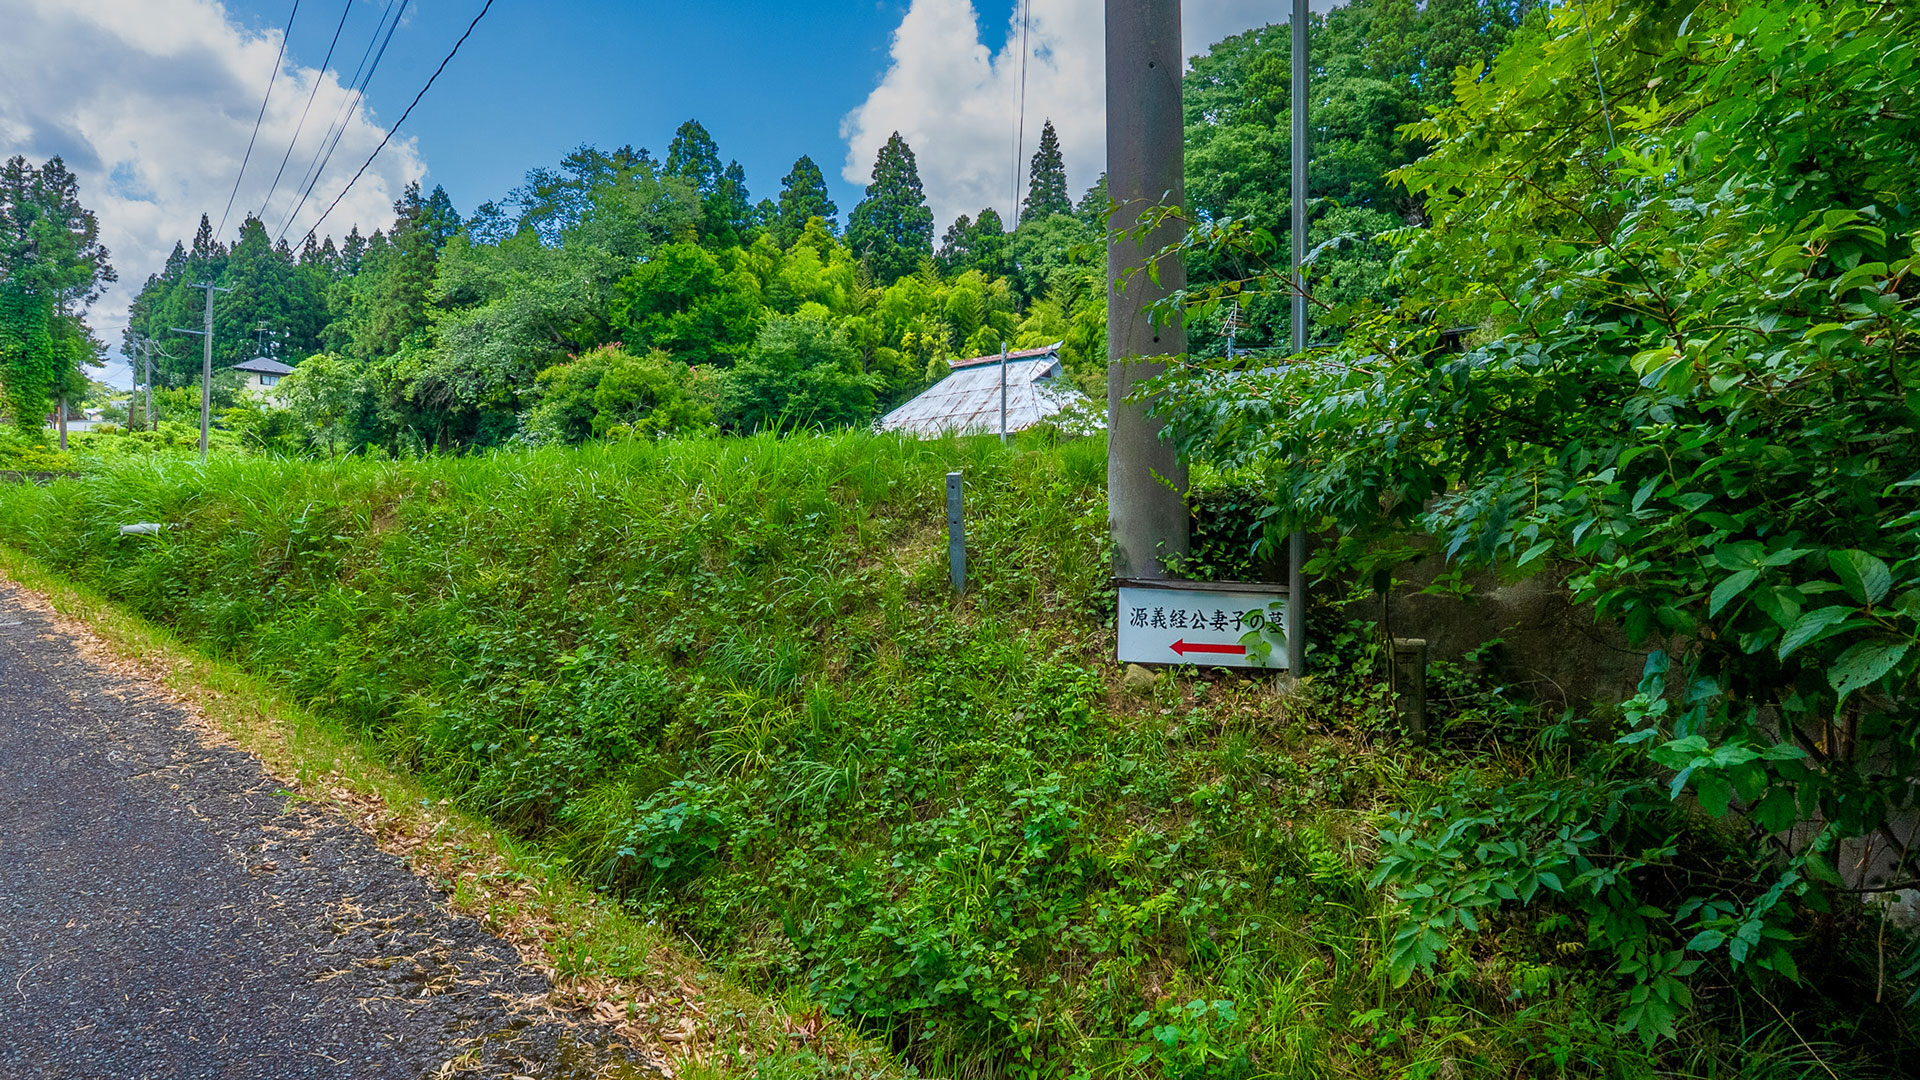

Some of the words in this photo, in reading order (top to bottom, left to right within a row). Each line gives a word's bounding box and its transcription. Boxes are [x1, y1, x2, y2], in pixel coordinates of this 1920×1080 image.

[1130, 606, 1285, 634] 源義経公妻子の墓
